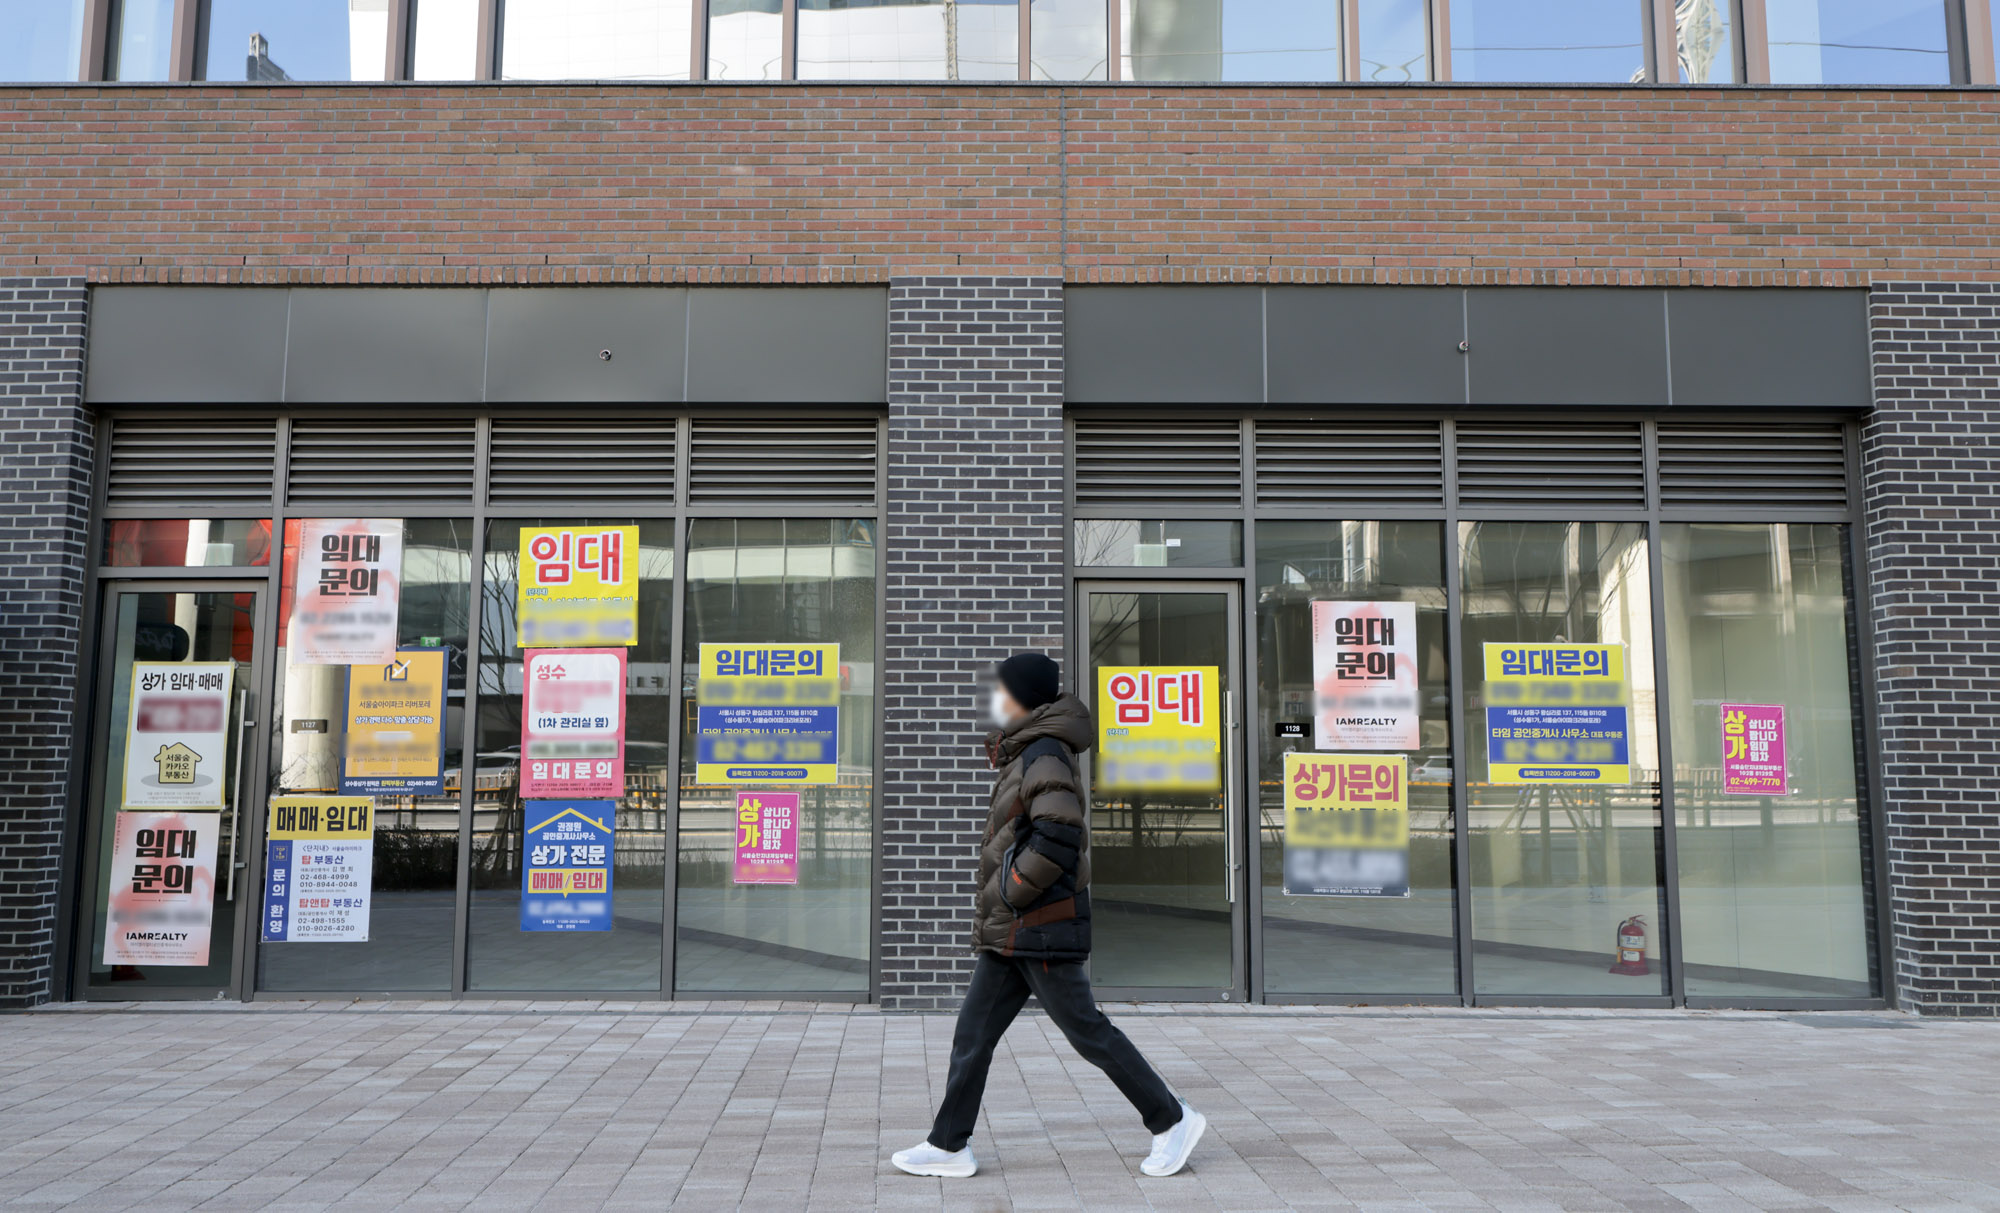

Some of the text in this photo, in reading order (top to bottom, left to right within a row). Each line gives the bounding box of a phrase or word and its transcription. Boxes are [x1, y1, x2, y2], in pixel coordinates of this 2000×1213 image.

[321, 534, 381, 562] 임대
[530, 532, 621, 584] 임대
[318, 568, 379, 596] 문의
[1335, 618, 1395, 646] 임대
[536, 664, 567, 680] 성수
[716, 650, 823, 676] 임대문의
[1335, 652, 1396, 680] 문의
[1501, 649, 1608, 676] 임대문의
[141, 673, 166, 691] 상가
[1109, 672, 1202, 725] 임대
[538, 717, 609, 729] (1차 관리실 옆)
[1336, 717, 1397, 726] IAMREALTY
[1749, 719, 1776, 729] 삽니다
[1492, 728, 1510, 738] 타임
[1513, 728, 1560, 738] 공인중개사
[1562, 728, 1589, 738] 사무소
[1724, 710, 1748, 759] 상가
[1749, 730, 1777, 741] 팝니다
[166, 754, 190, 762] 서울숲
[165, 771, 189, 779] 부동산
[532, 761, 612, 780] 임대문의
[1294, 763, 1399, 802] 상가문의
[1730, 777, 1781, 786] 02-499-7770
[276, 806, 368, 831] 매매·임대
[763, 807, 791, 817] 삽니다
[739, 798, 762, 848] 상가
[763, 818, 791, 829] 팝니다
[136, 829, 197, 858] 임대
[302, 855, 344, 865] 탑 부동산
[531, 845, 606, 865] 상가 전문
[132, 865, 194, 894] 문의
[332, 898, 363, 908] 부동산
[126, 932, 188, 941] IAMREALTY
